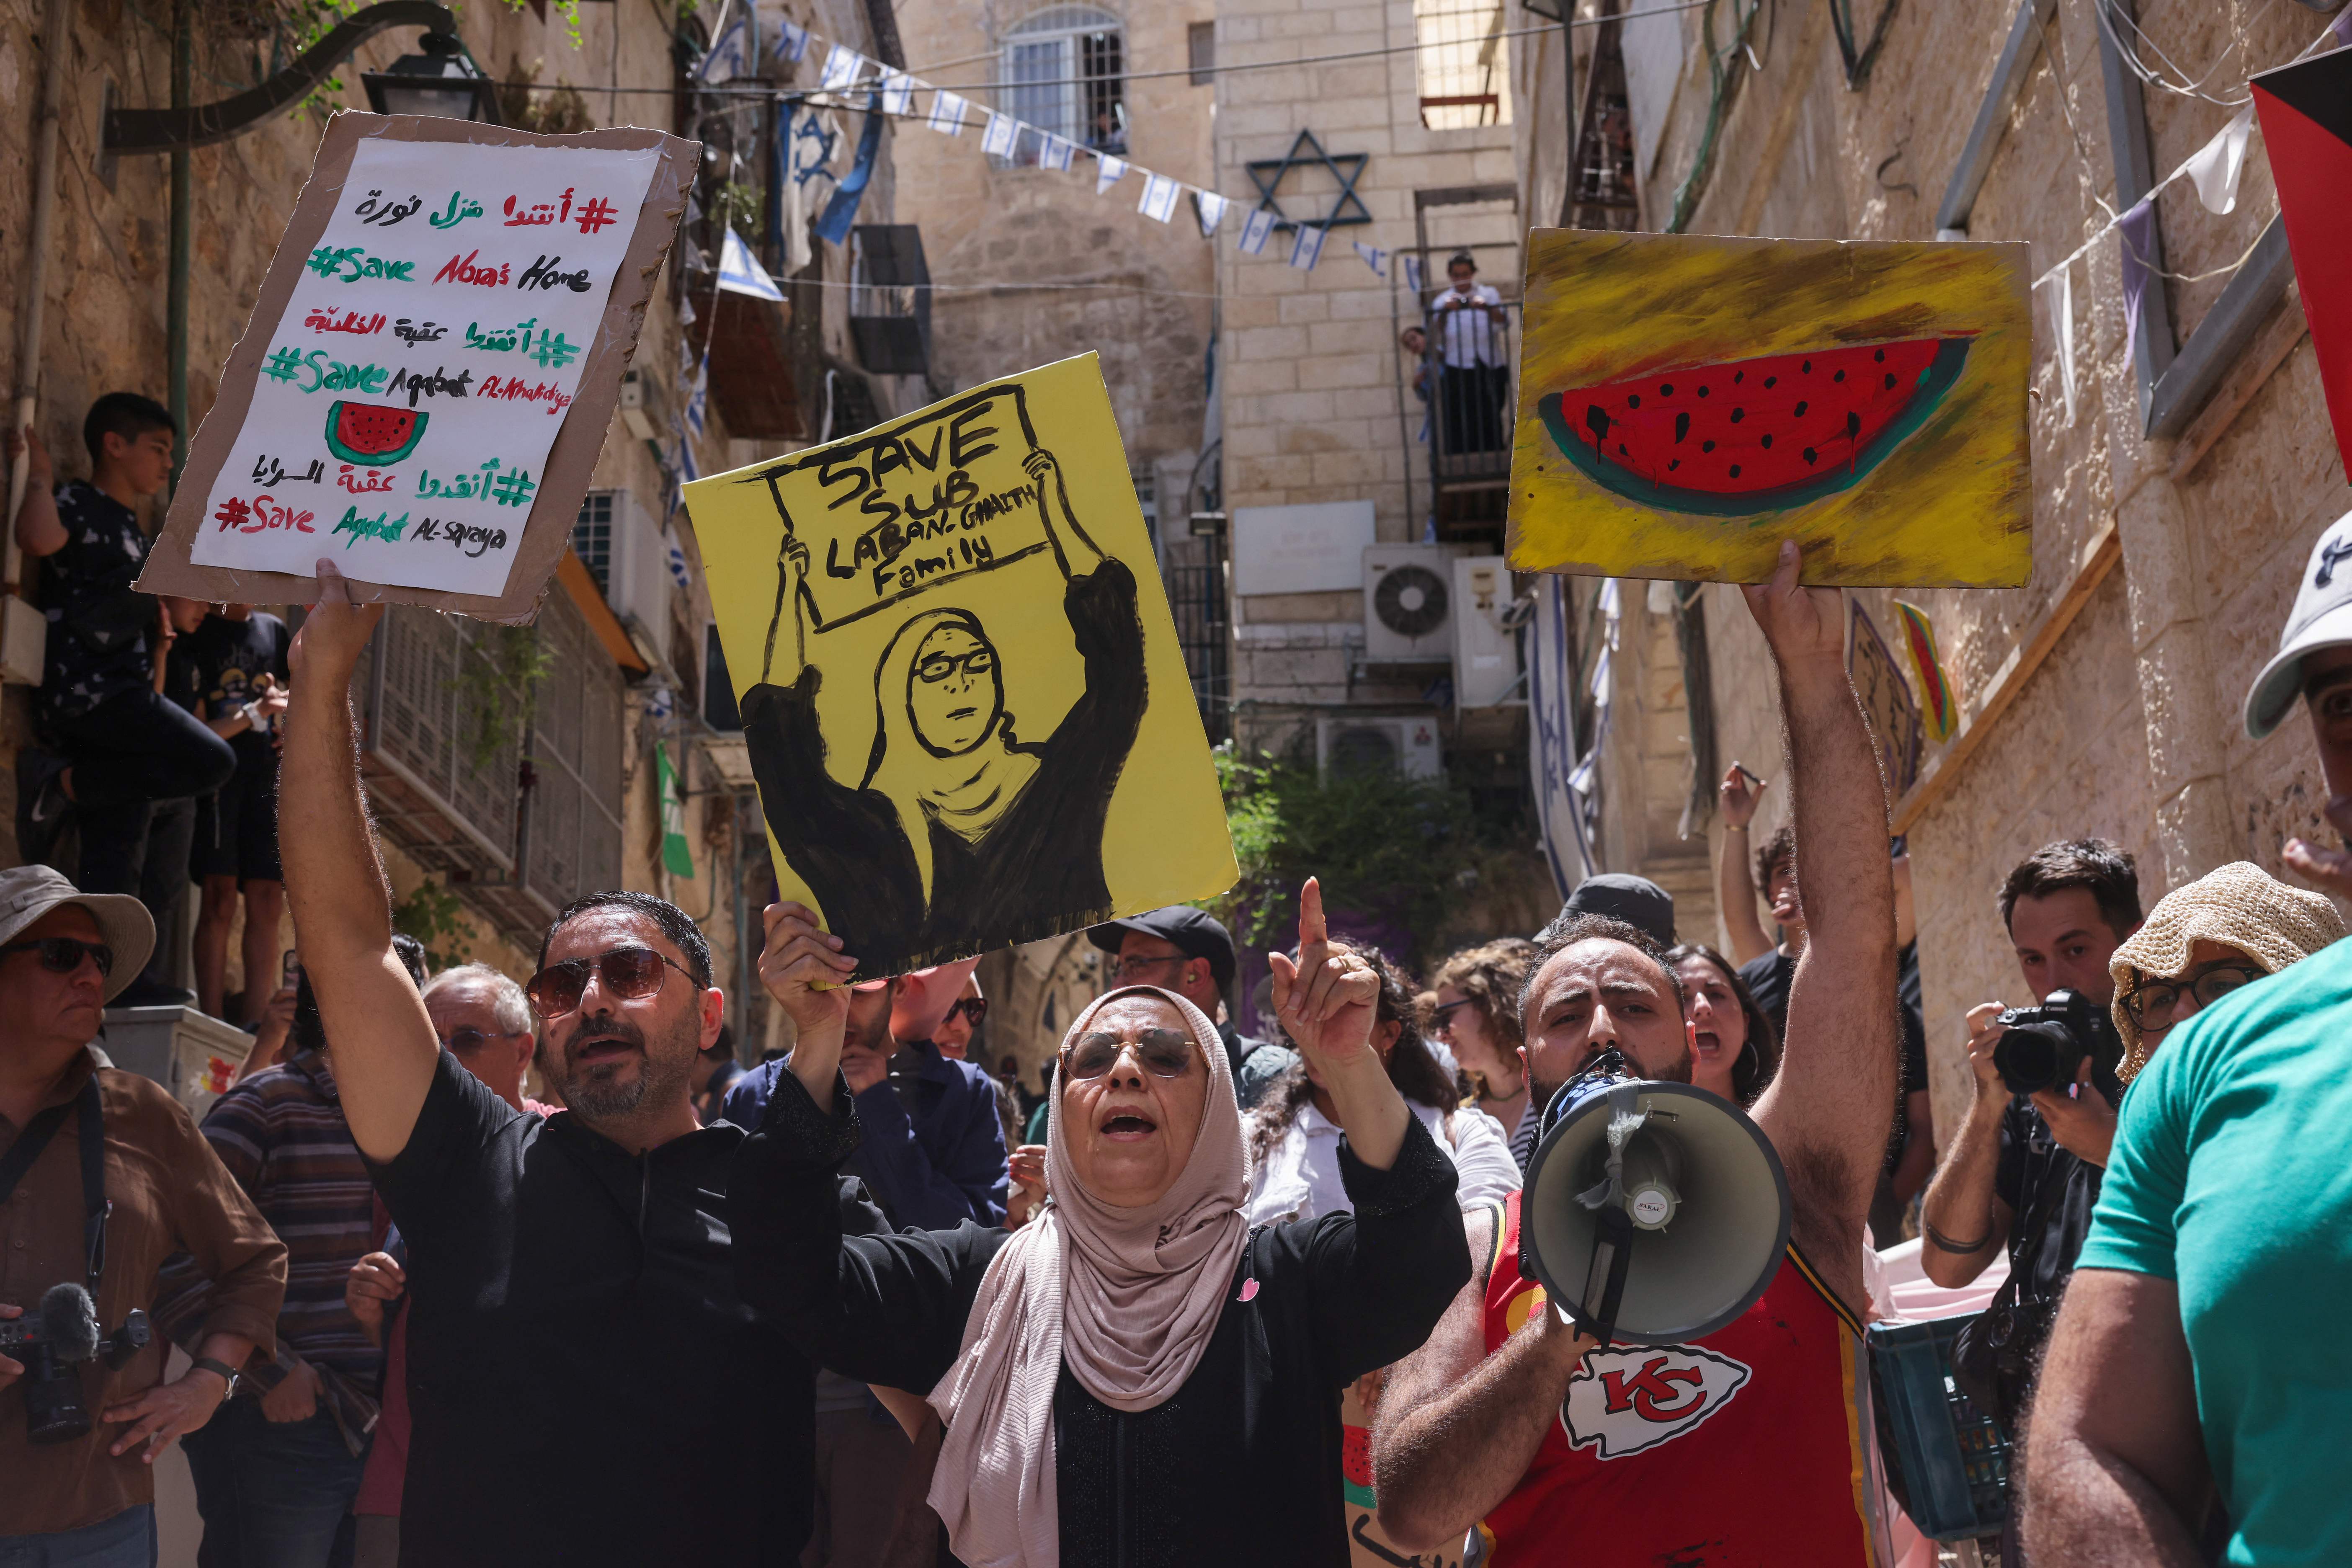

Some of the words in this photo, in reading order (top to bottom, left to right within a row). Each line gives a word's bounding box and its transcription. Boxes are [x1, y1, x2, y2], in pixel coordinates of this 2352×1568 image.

[355, 190, 422, 227] نورة
[429, 191, 483, 229] منزل
[307, 246, 415, 283] #Save
[517, 255, 592, 293] Home
[394, 318, 448, 348] عقبة
[260, 346, 389, 394] #Save
[252, 454, 325, 487] السرايا
[818, 401, 1000, 510] SAVE
[214, 495, 315, 534] #Save
[860, 470, 979, 536] SUB
[874, 535, 993, 597] Family
[1639, 1203, 1660, 1212] SAKAL
[1599, 1356, 1707, 1423] KC
